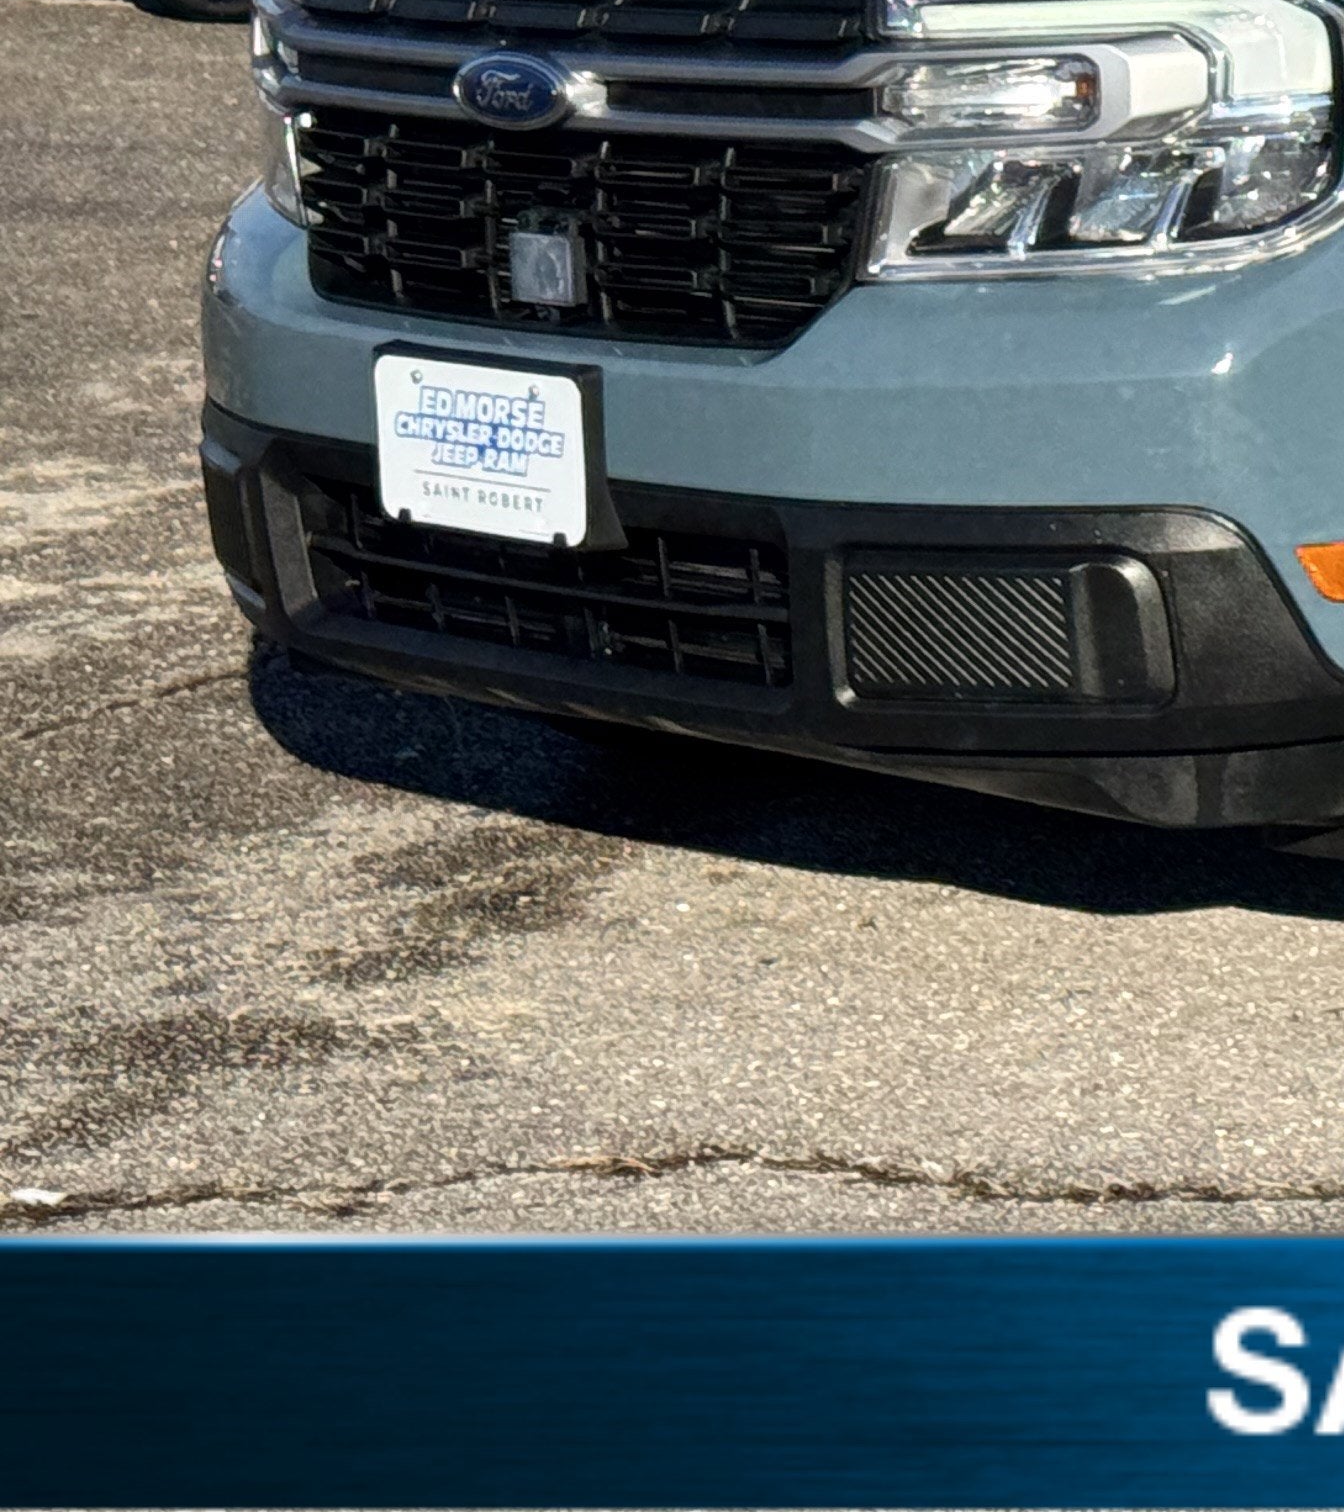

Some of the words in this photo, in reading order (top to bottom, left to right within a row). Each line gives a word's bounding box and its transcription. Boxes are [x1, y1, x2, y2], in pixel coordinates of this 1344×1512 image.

[474, 69, 535, 111] Ford
[419, 386, 453, 417] ED
[454, 390, 546, 431] MORSE
[422, 480, 470, 504] SAINT
[477, 488, 545, 513] ROBERT
